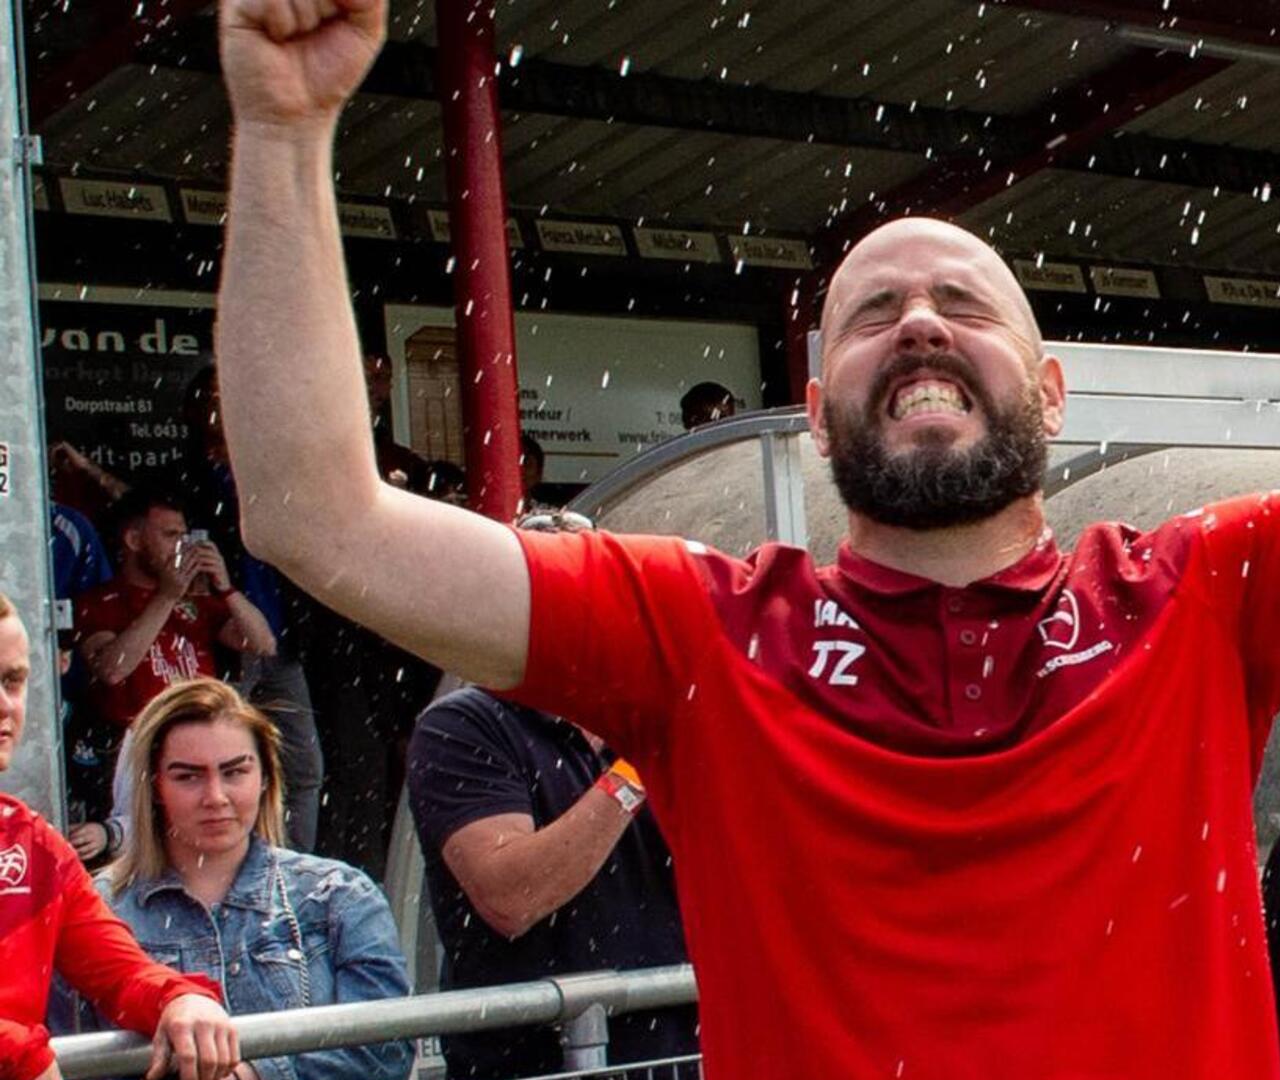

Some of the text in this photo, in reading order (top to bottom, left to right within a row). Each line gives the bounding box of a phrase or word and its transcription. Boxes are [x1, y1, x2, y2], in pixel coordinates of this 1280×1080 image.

[64, 396, 152, 414] Dorpstraat 81
[808, 640, 866, 685] TZ
